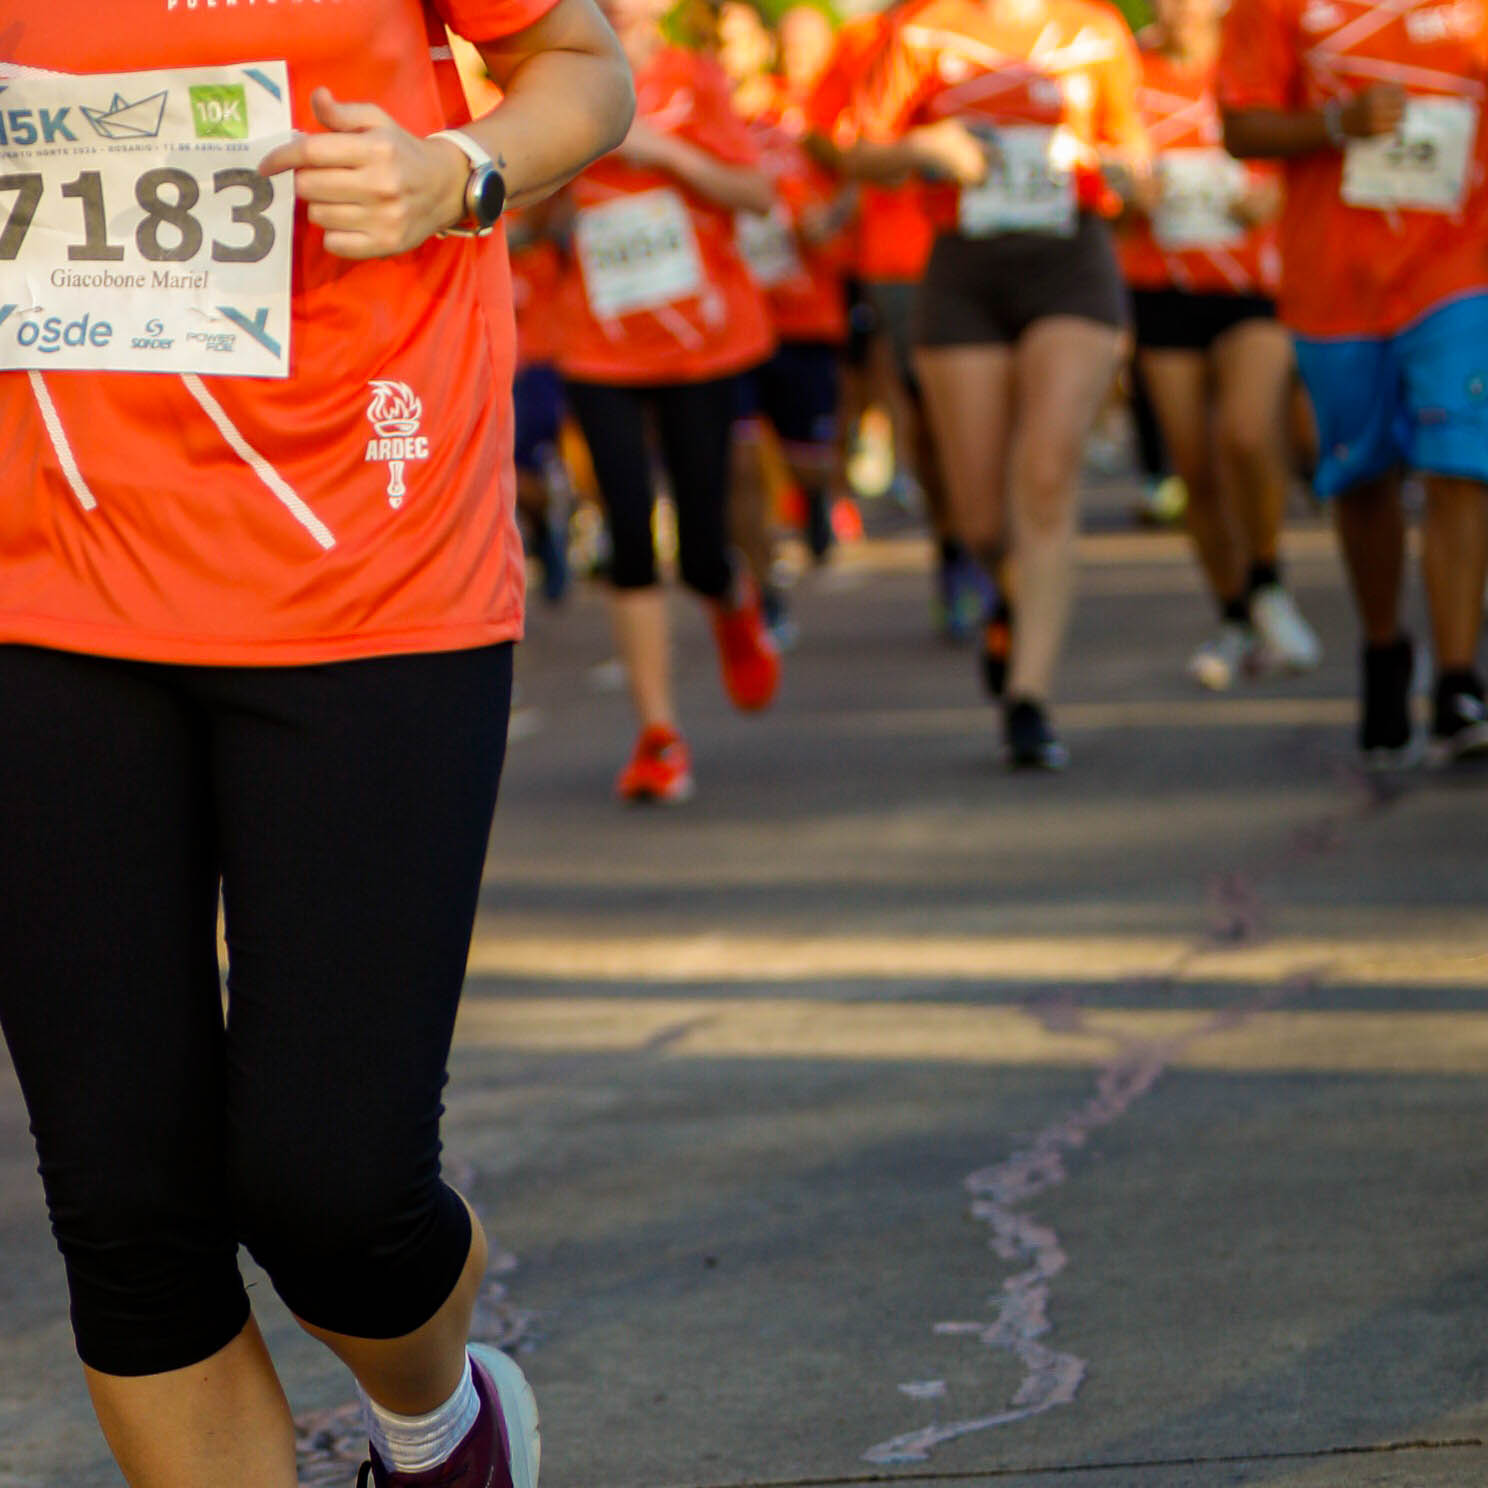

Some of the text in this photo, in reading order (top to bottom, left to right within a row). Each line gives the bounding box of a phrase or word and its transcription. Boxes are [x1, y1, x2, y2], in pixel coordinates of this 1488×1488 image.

[195, 99, 242, 124] 10K
[50, 268, 209, 289] Giacobone Mariel
[17, 313, 113, 350] osde
[364, 436, 430, 462] ARDEC
